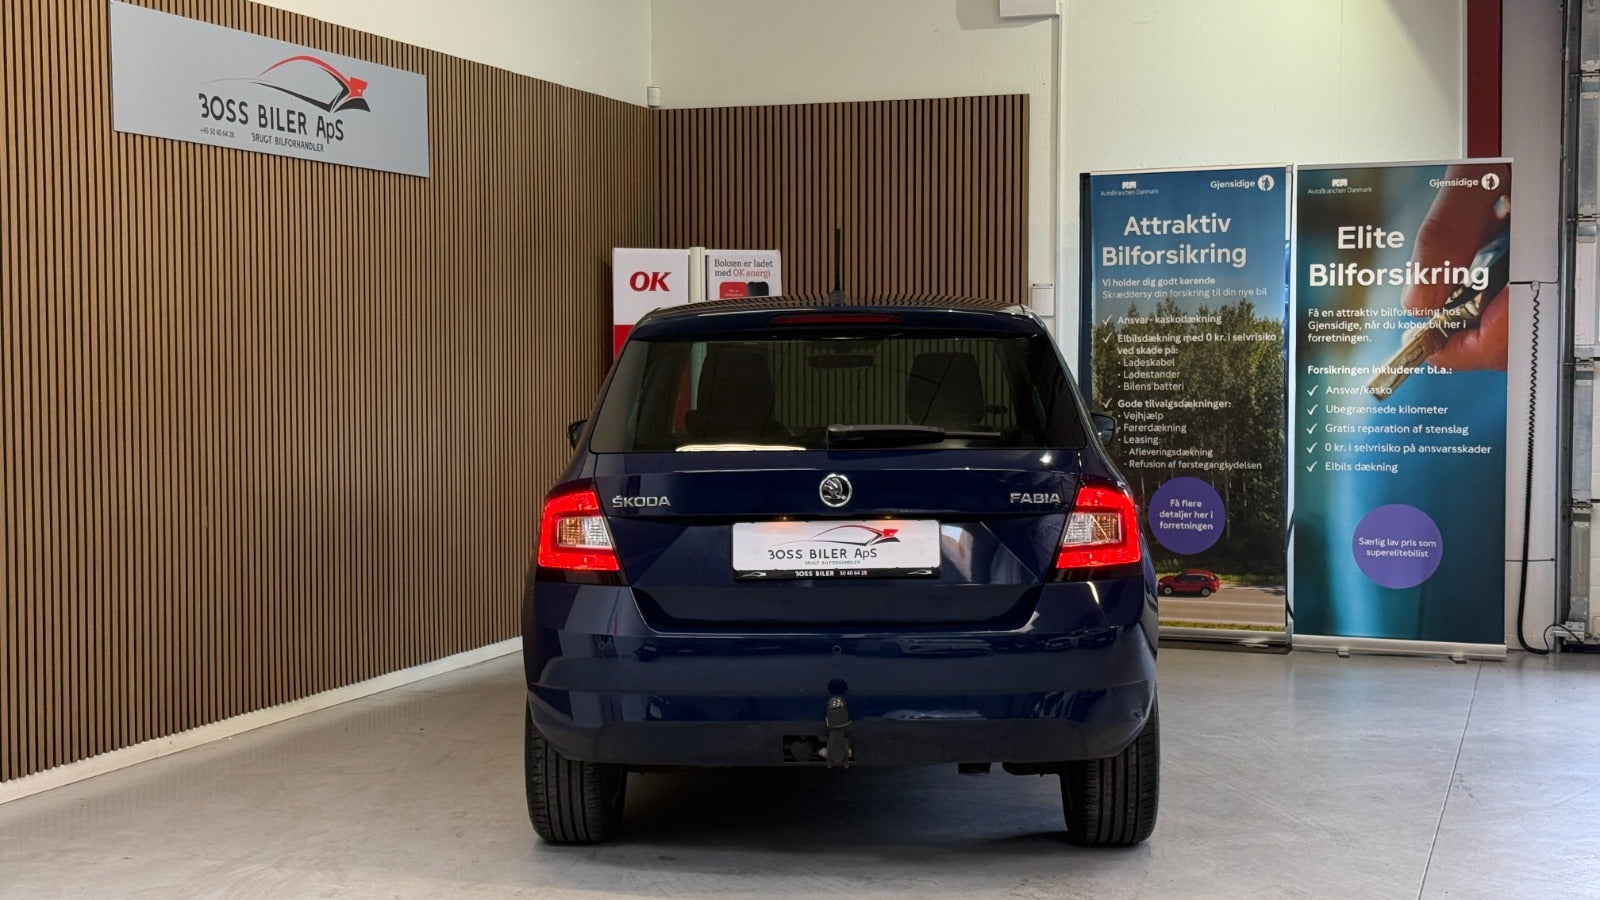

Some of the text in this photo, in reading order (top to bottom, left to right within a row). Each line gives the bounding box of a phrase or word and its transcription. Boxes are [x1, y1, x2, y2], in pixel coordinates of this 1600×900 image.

[258, 104, 308, 136] BILER
[316, 115, 344, 144] ApS
[275, 135, 324, 152] BILFORHANDLER
[1210, 180, 1256, 190] Gjensidige
[1429, 178, 1478, 188] Gjensidige
[1124, 213, 1231, 236] Attraktiv
[1338, 224, 1404, 250] Elite
[1102, 244, 1246, 268] Bilforsikring
[714, 258, 742, 268] Boksen
[754, 259, 774, 268] ladet
[714, 269, 731, 277] med
[746, 270, 770, 279] energi
[1310, 260, 1489, 290] Bilforsikring
[630, 271, 672, 292] OK
[1102, 277, 1216, 288] Vi holder dig godt kørende
[1102, 288, 1268, 300] Skræddersy din forsikring til din nye bil
[1308, 308, 1320, 317] Få
[1336, 308, 1378, 317] attraktiv
[1380, 308, 1440, 318] bilforsikring
[1442, 308, 1460, 316] hos
[1118, 315, 1222, 325] Ansvar- kaskodækning
[1308, 320, 1466, 331] Gjensidige, når du køber bil her i
[1118, 333, 1276, 344] Elbilsdækning med 0 kr. i selvrisiko
[1308, 334, 1372, 344] forretningen.
[1136, 347, 1163, 355] skade
[1164, 346, 1179, 356] på:
[1123, 358, 1175, 367] Ladeskabel
[1123, 370, 1180, 378] Ladestander
[1308, 366, 1452, 376] Forsikringen inkluderer bl.a.:
[1123, 382, 1184, 390] Bilens batteri
[1326, 386, 1392, 396] Ansvar/kasko
[1118, 400, 1232, 410] Gode tilvalgsdækninger:
[1326, 405, 1448, 415] Ubegrænsede kilometer
[1123, 412, 1164, 421] Vejhjælp
[1124, 424, 1187, 434] Førerdækning
[1325, 424, 1469, 436] Gratis reparation af stenslag
[1124, 436, 1161, 445] Leasing:
[1128, 448, 1213, 458] Afleveringsdækning
[1324, 443, 1492, 454] 0 kr. i selvrisiko på ansvarsskader
[1129, 460, 1262, 470] Refusion af førstegangsydelsen
[1325, 462, 1398, 474] Elbils dækning
[612, 494, 671, 508] ŠKODA
[1010, 492, 1061, 504] FABIA
[1170, 499, 1202, 508] Få flere
[1160, 510, 1214, 520] detaljer her i
[1160, 522, 1214, 532] forretningen
[1358, 537, 1386, 548] Særlig
[1388, 538, 1399, 546] lav
[1400, 538, 1416, 548] pris
[810, 548, 847, 558] BILER
[854, 548, 877, 560] ApS
[1366, 550, 1428, 558] superelitebilist
